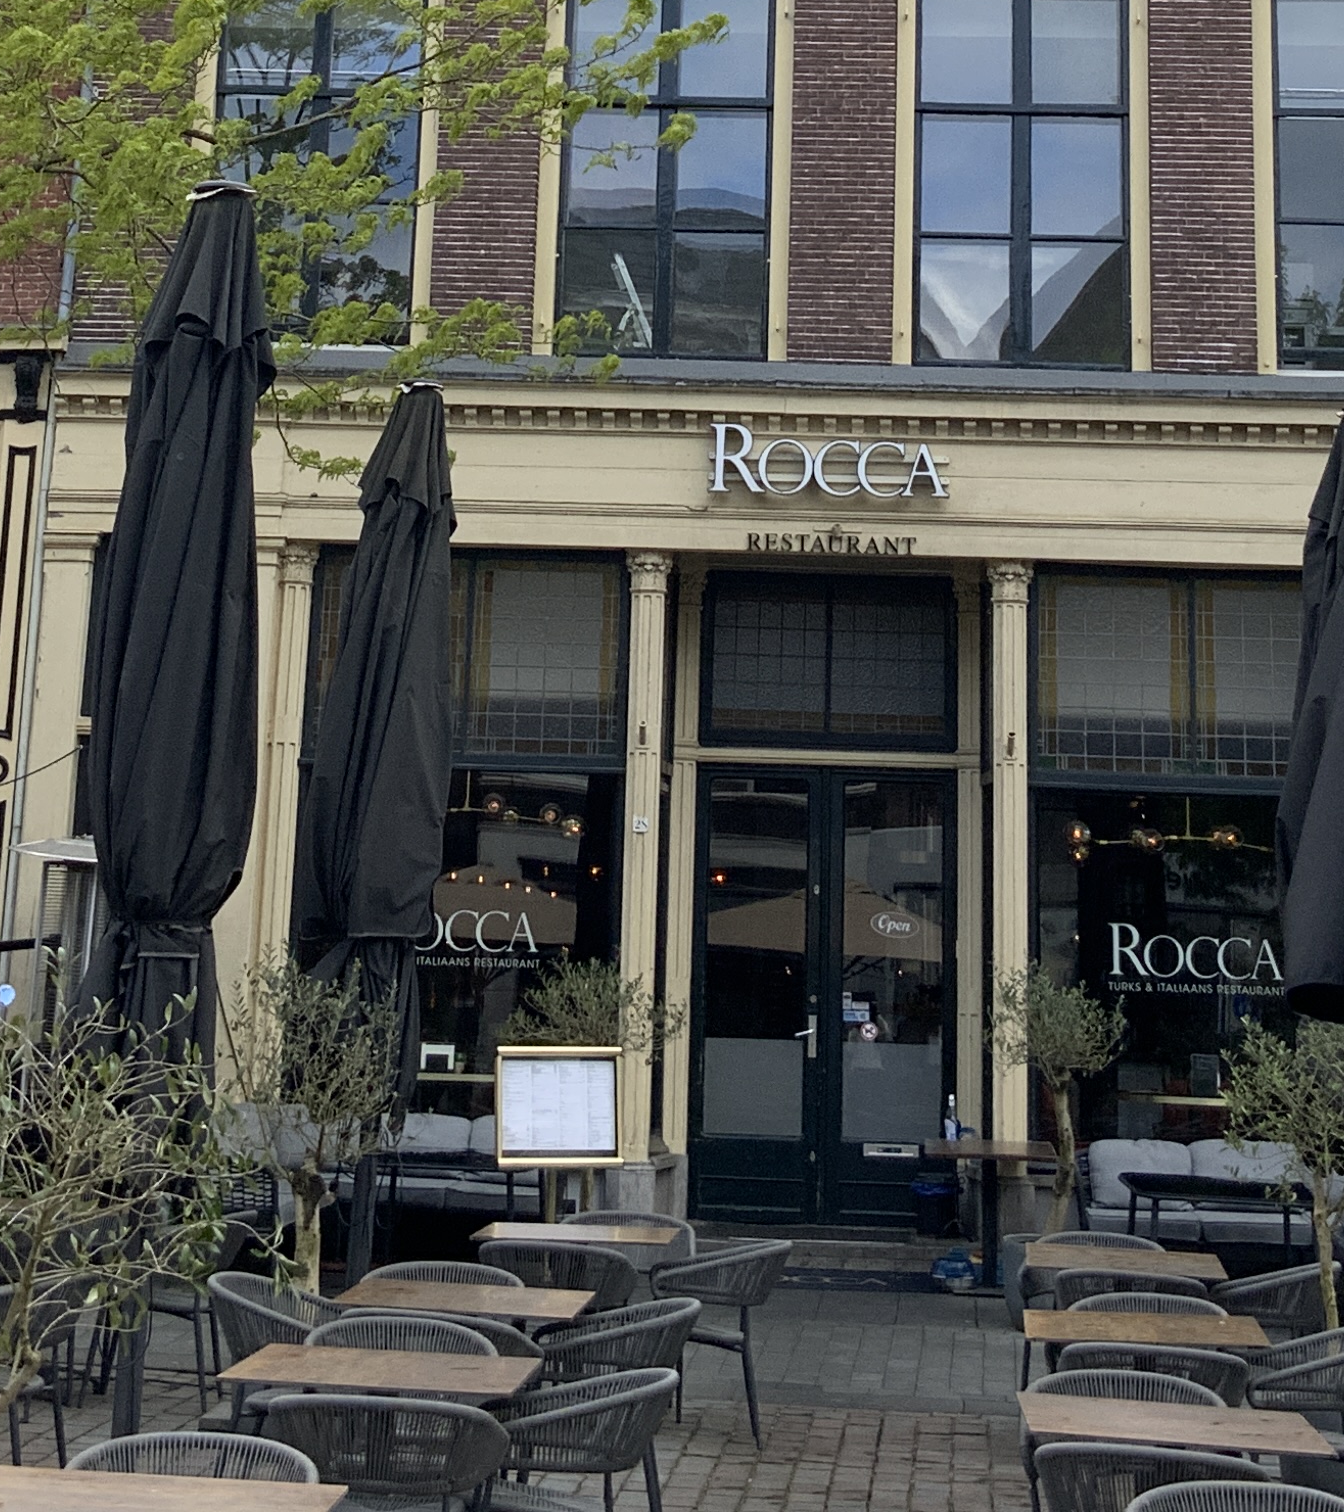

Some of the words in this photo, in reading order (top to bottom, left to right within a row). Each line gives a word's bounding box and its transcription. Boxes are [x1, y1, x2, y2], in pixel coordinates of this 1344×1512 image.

[709, 423, 949, 498] ROCCA
[746, 532, 917, 555] RESTAURANT
[415, 909, 539, 953] CCA
[878, 914, 911, 934] Open
[416, 955, 471, 967] ITALIAANS
[473, 957, 540, 969] RESTAURANT
[1108, 922, 1284, 981] ROCCA
[1108, 980, 1142, 992] TURKS
[1144, 981, 1153, 992] &
[1156, 982, 1214, 994] ITALIAANS
[1216, 984, 1285, 996] RESTAURANT
